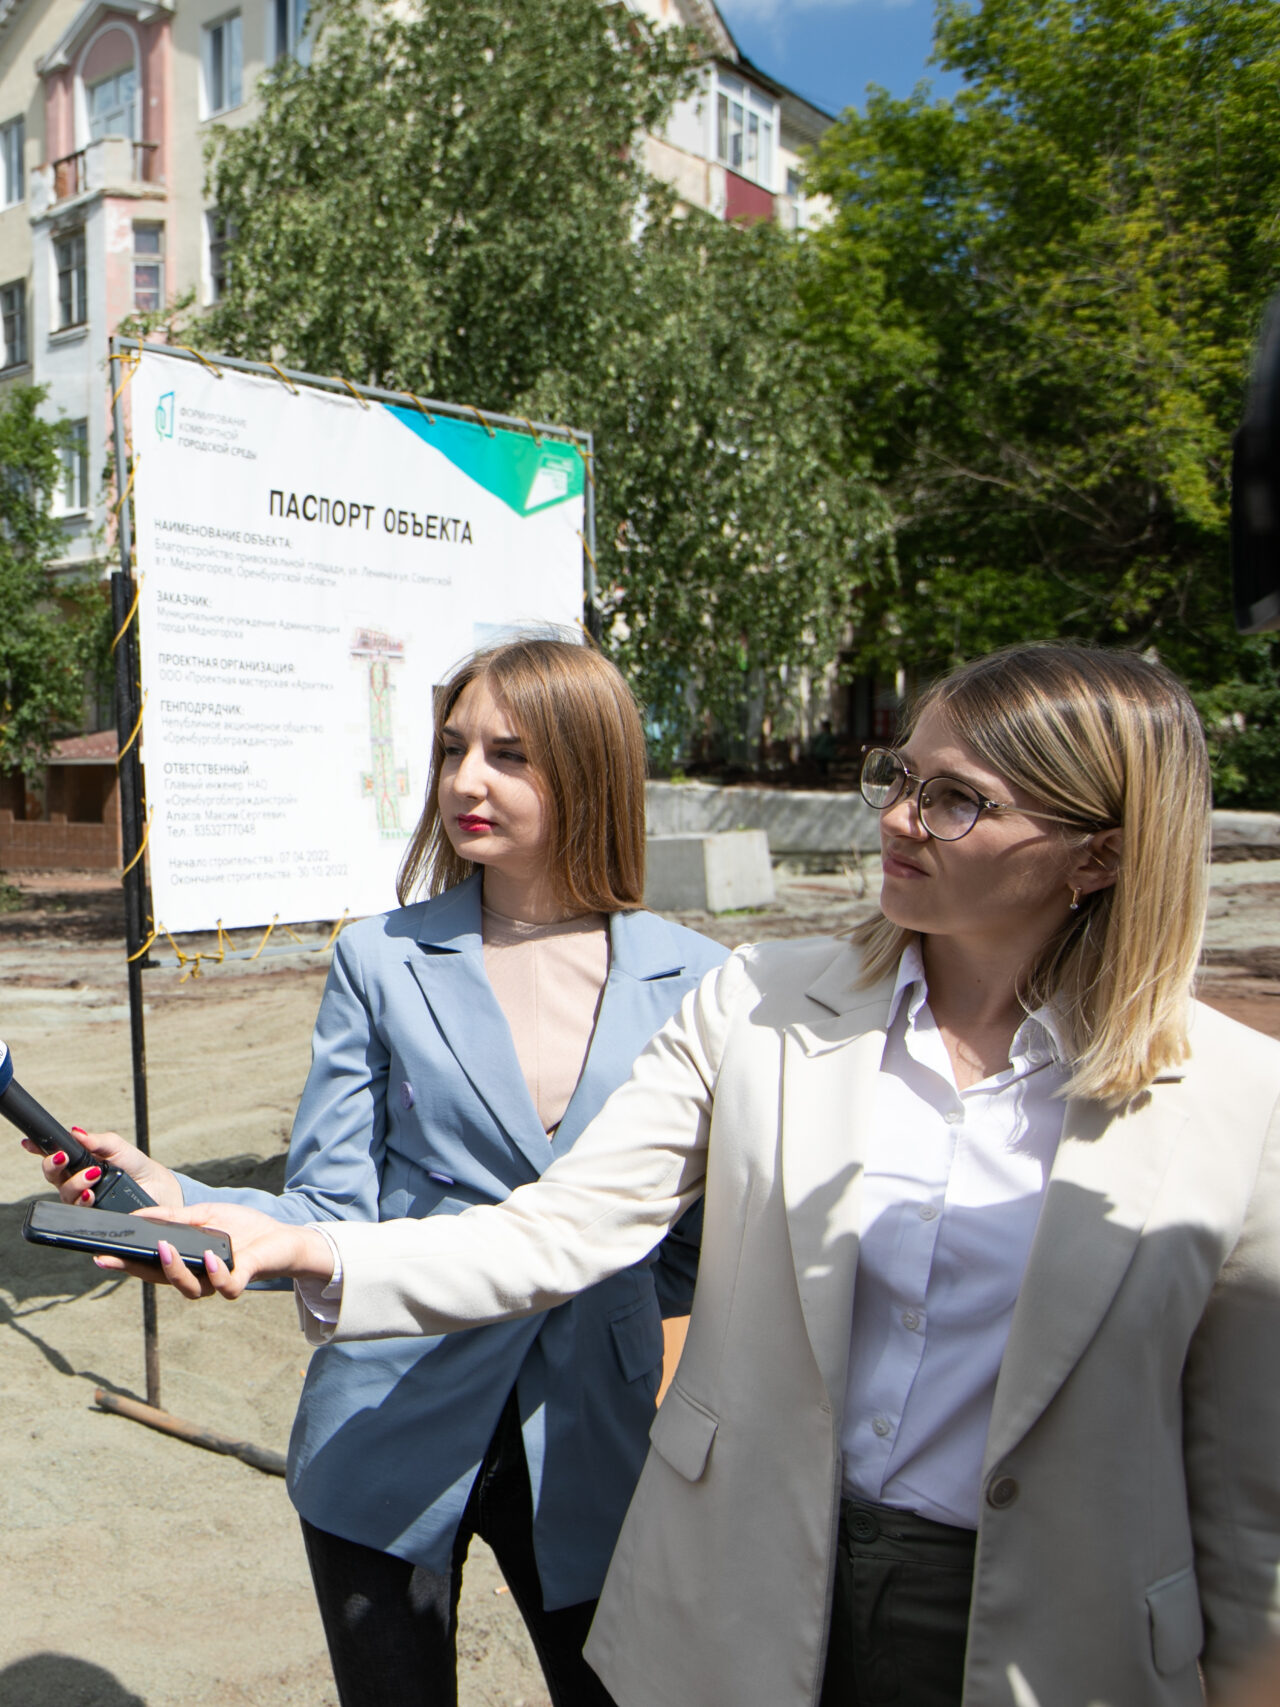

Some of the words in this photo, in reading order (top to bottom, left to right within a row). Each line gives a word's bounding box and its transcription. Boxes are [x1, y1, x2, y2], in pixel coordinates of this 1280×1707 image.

[180, 407, 247, 428] ФОРМИРОВАНИЕ
[179, 423, 239, 440] КОМФОРТНОЙ
[178, 437, 229, 455] ГОРОДСКОЙ
[231, 446, 258, 460] СРЕДЫ
[270, 490, 375, 530] ПАСПОРТ
[384, 508, 473, 545] ОБЪЕКТА
[154, 519, 241, 543] НАИМЕНОВАНИЕ
[243, 532, 293, 549] ОБЪЕКТА:
[155, 538, 233, 560] Благоустройство
[236, 551, 306, 568] привокзальной
[237, 566, 302, 583] Оренбургской
[156, 590, 212, 607] ЗАКАЗЧИК:
[157, 606, 225, 624] Муниципальное
[157, 622, 186, 634] города
[188, 624, 243, 639] Медногорска
[158, 652, 218, 668] ПРОЕКТНАЯ
[220, 658, 296, 675] ОРГАНИЗАЦИЯ:
[159, 669, 183, 682] ООО
[239, 676, 289, 690] мастерская
[160, 700, 245, 716] ГЕНПОДРЯДЧИК:
[164, 777, 203, 790] Главный
[205, 780, 244, 791] инженер
[169, 856, 207, 868] Начало
[209, 854, 273, 869] строительства
[170, 872, 225, 887] Окончание
[227, 870, 290, 885] строительства
